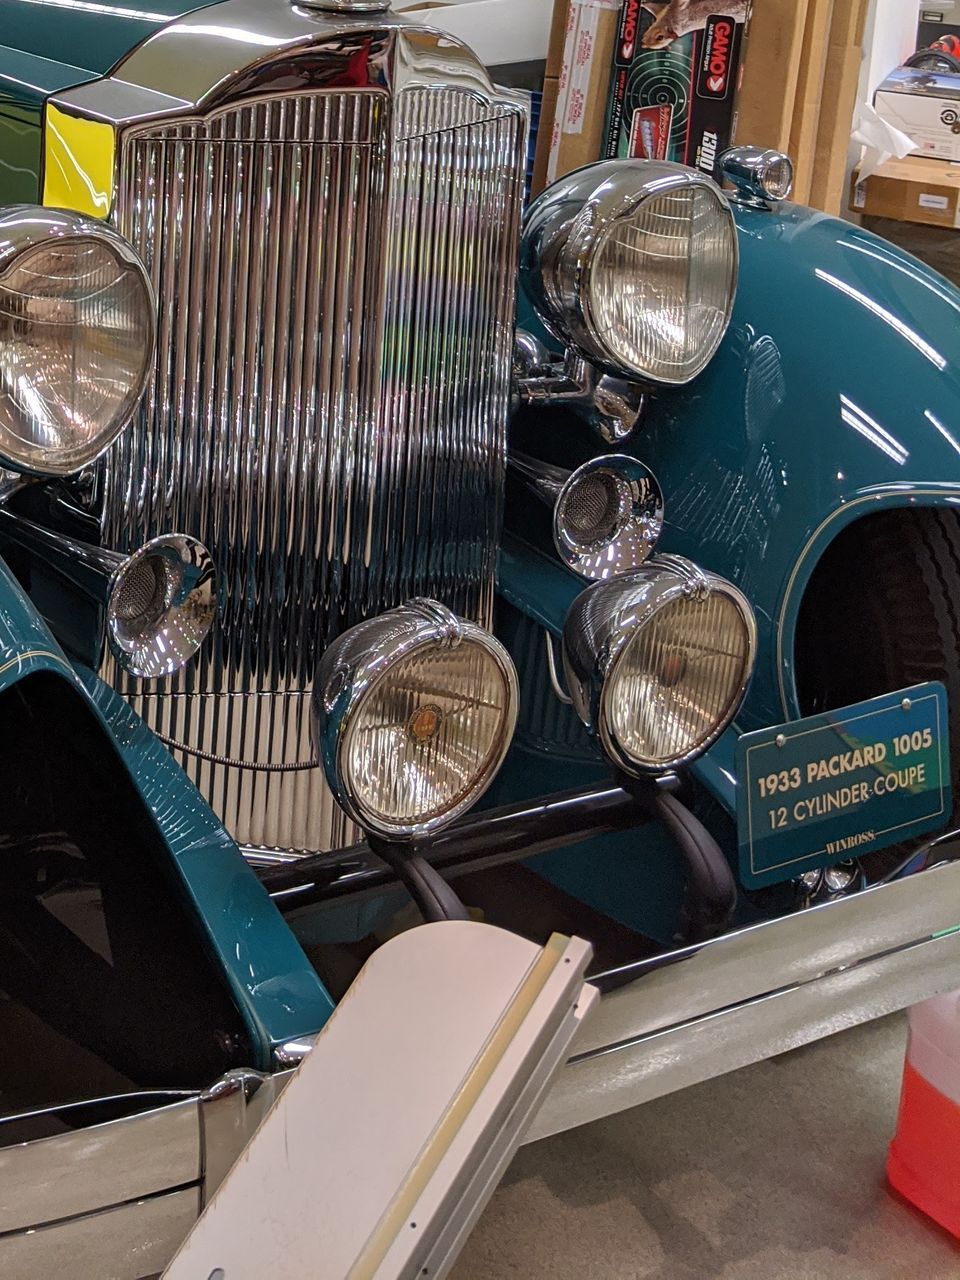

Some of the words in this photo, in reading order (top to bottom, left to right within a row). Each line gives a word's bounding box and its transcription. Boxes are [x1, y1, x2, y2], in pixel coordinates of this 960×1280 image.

[708, 21, 731, 75] GAMO
[700, 130, 718, 172] 1300
[757, 767, 802, 799] 1933
[806, 742, 887, 784] PACKARD
[892, 727, 933, 757] 1005
[768, 806, 788, 830] 12
[792, 781, 869, 821] CYLINDER
[873, 763, 926, 796] COUPE
[825, 830, 876, 855] WINROSS
